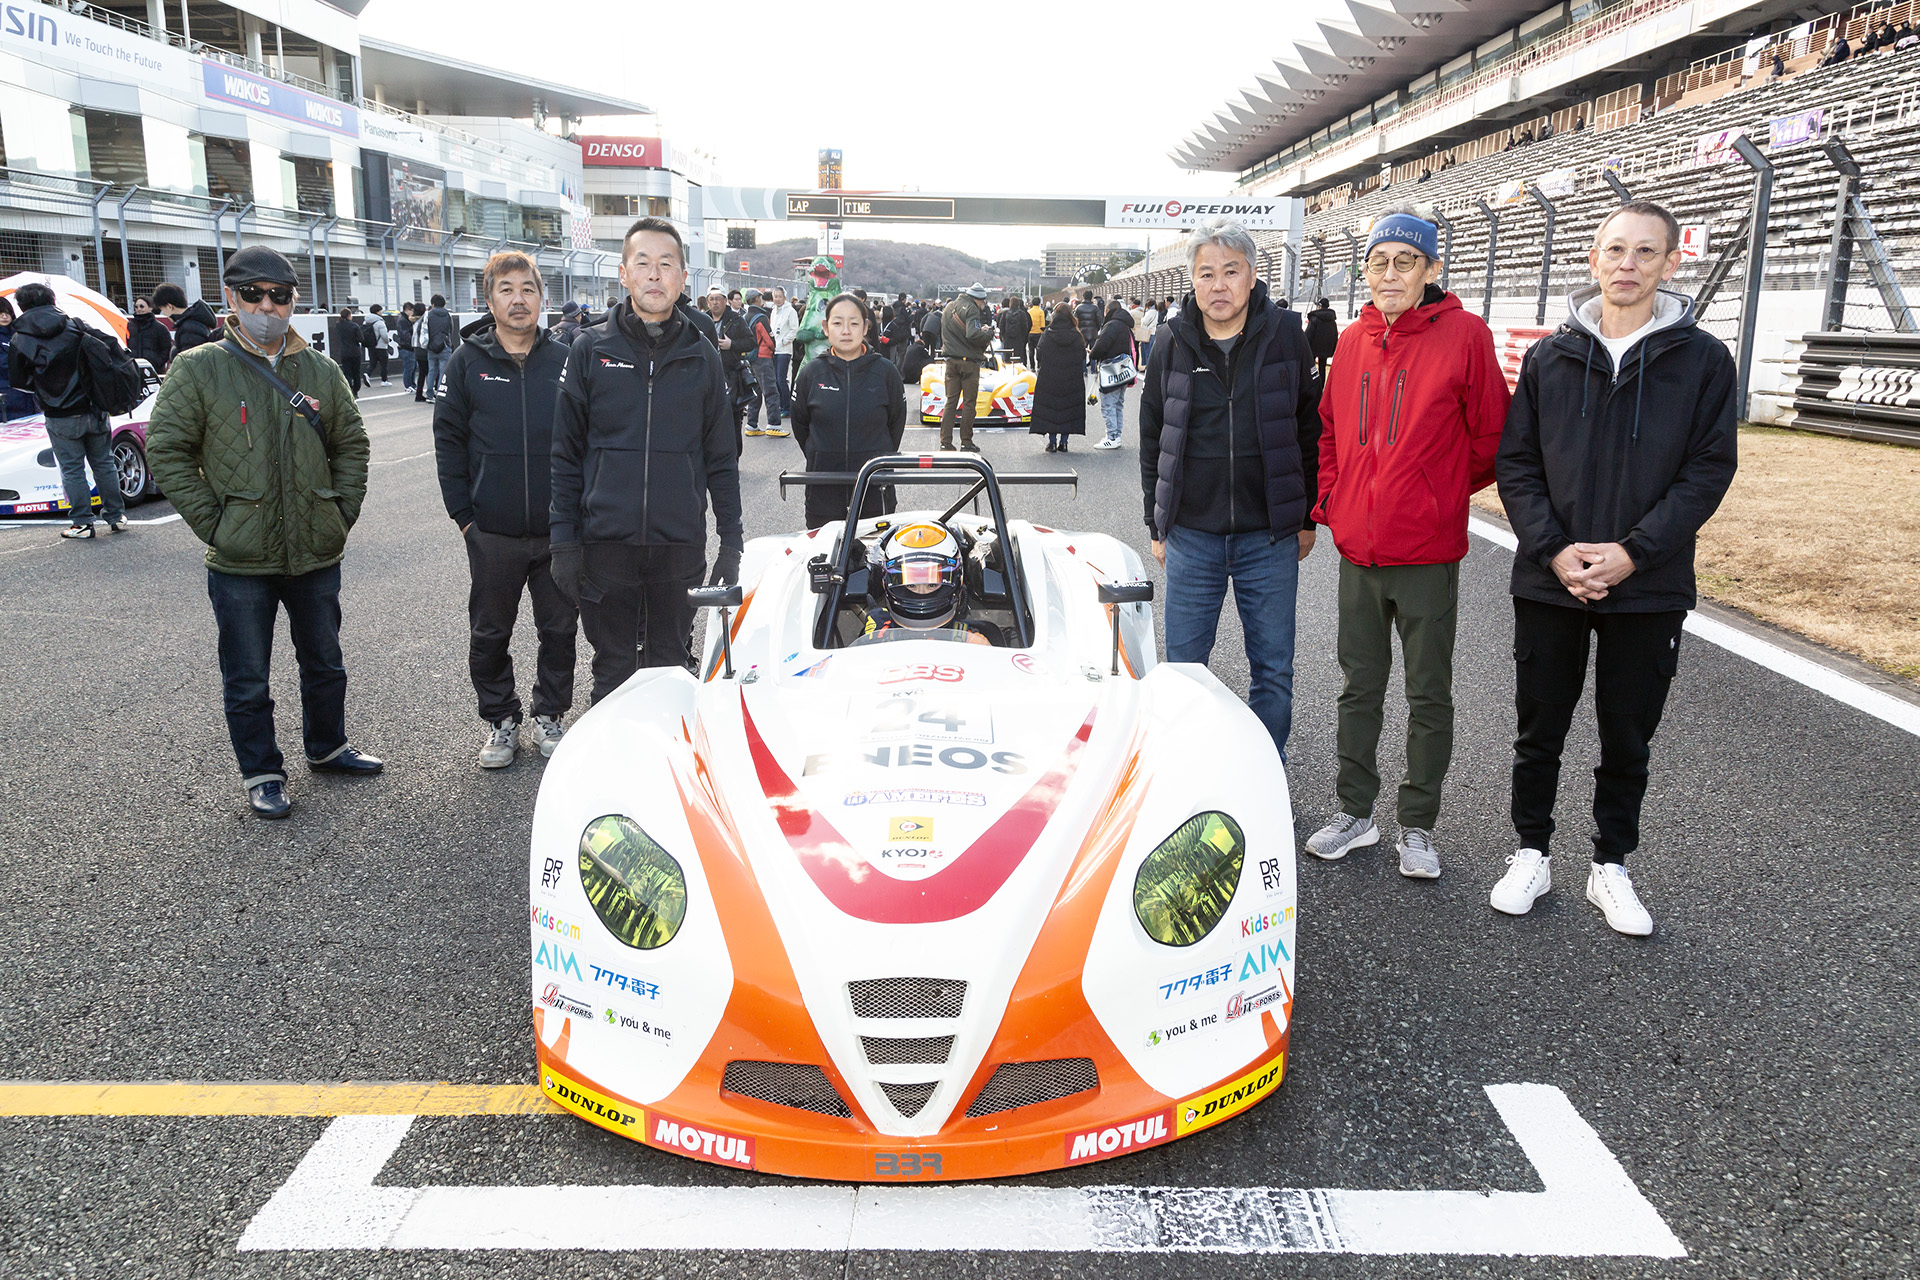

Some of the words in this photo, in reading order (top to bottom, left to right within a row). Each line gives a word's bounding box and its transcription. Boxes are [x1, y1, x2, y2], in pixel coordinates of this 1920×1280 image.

[64, 30, 82, 48] We
[85, 37, 113, 57] Touch
[116, 47, 132, 62] the
[134, 53, 163, 71] Future
[363, 119, 398, 141] Panasonic
[587, 143, 645, 158] DENSO
[789, 200, 810, 213] LAP
[845, 201, 871, 214] TIME
[1108, 369, 1131, 383] PUMA
[16, 502, 49, 512] MOTUL
[877, 663, 965, 685] BBS
[870, 698, 967, 733] 24
[802, 744, 1029, 776] ENEOS
[1241, 912, 1269, 938] Kids
[534, 939, 584, 982] AIM
[1238, 938, 1291, 982] AIM
[589, 964, 661, 1000] フクダ電子
[1159, 963, 1233, 1000] フクダ電子
[619, 1014, 639, 1030] you
[642, 1021, 651, 1034] &
[654, 1026, 671, 1040] me
[1165, 1024, 1187, 1041] you
[1189, 1019, 1199, 1032] &
[1200, 1013, 1218, 1028] me
[556, 1083, 637, 1127] DUNLOP
[1201, 1065, 1279, 1118] DUNLOP
[654, 1118, 751, 1165] MOTUL
[1069, 1114, 1168, 1161] MOTUL
